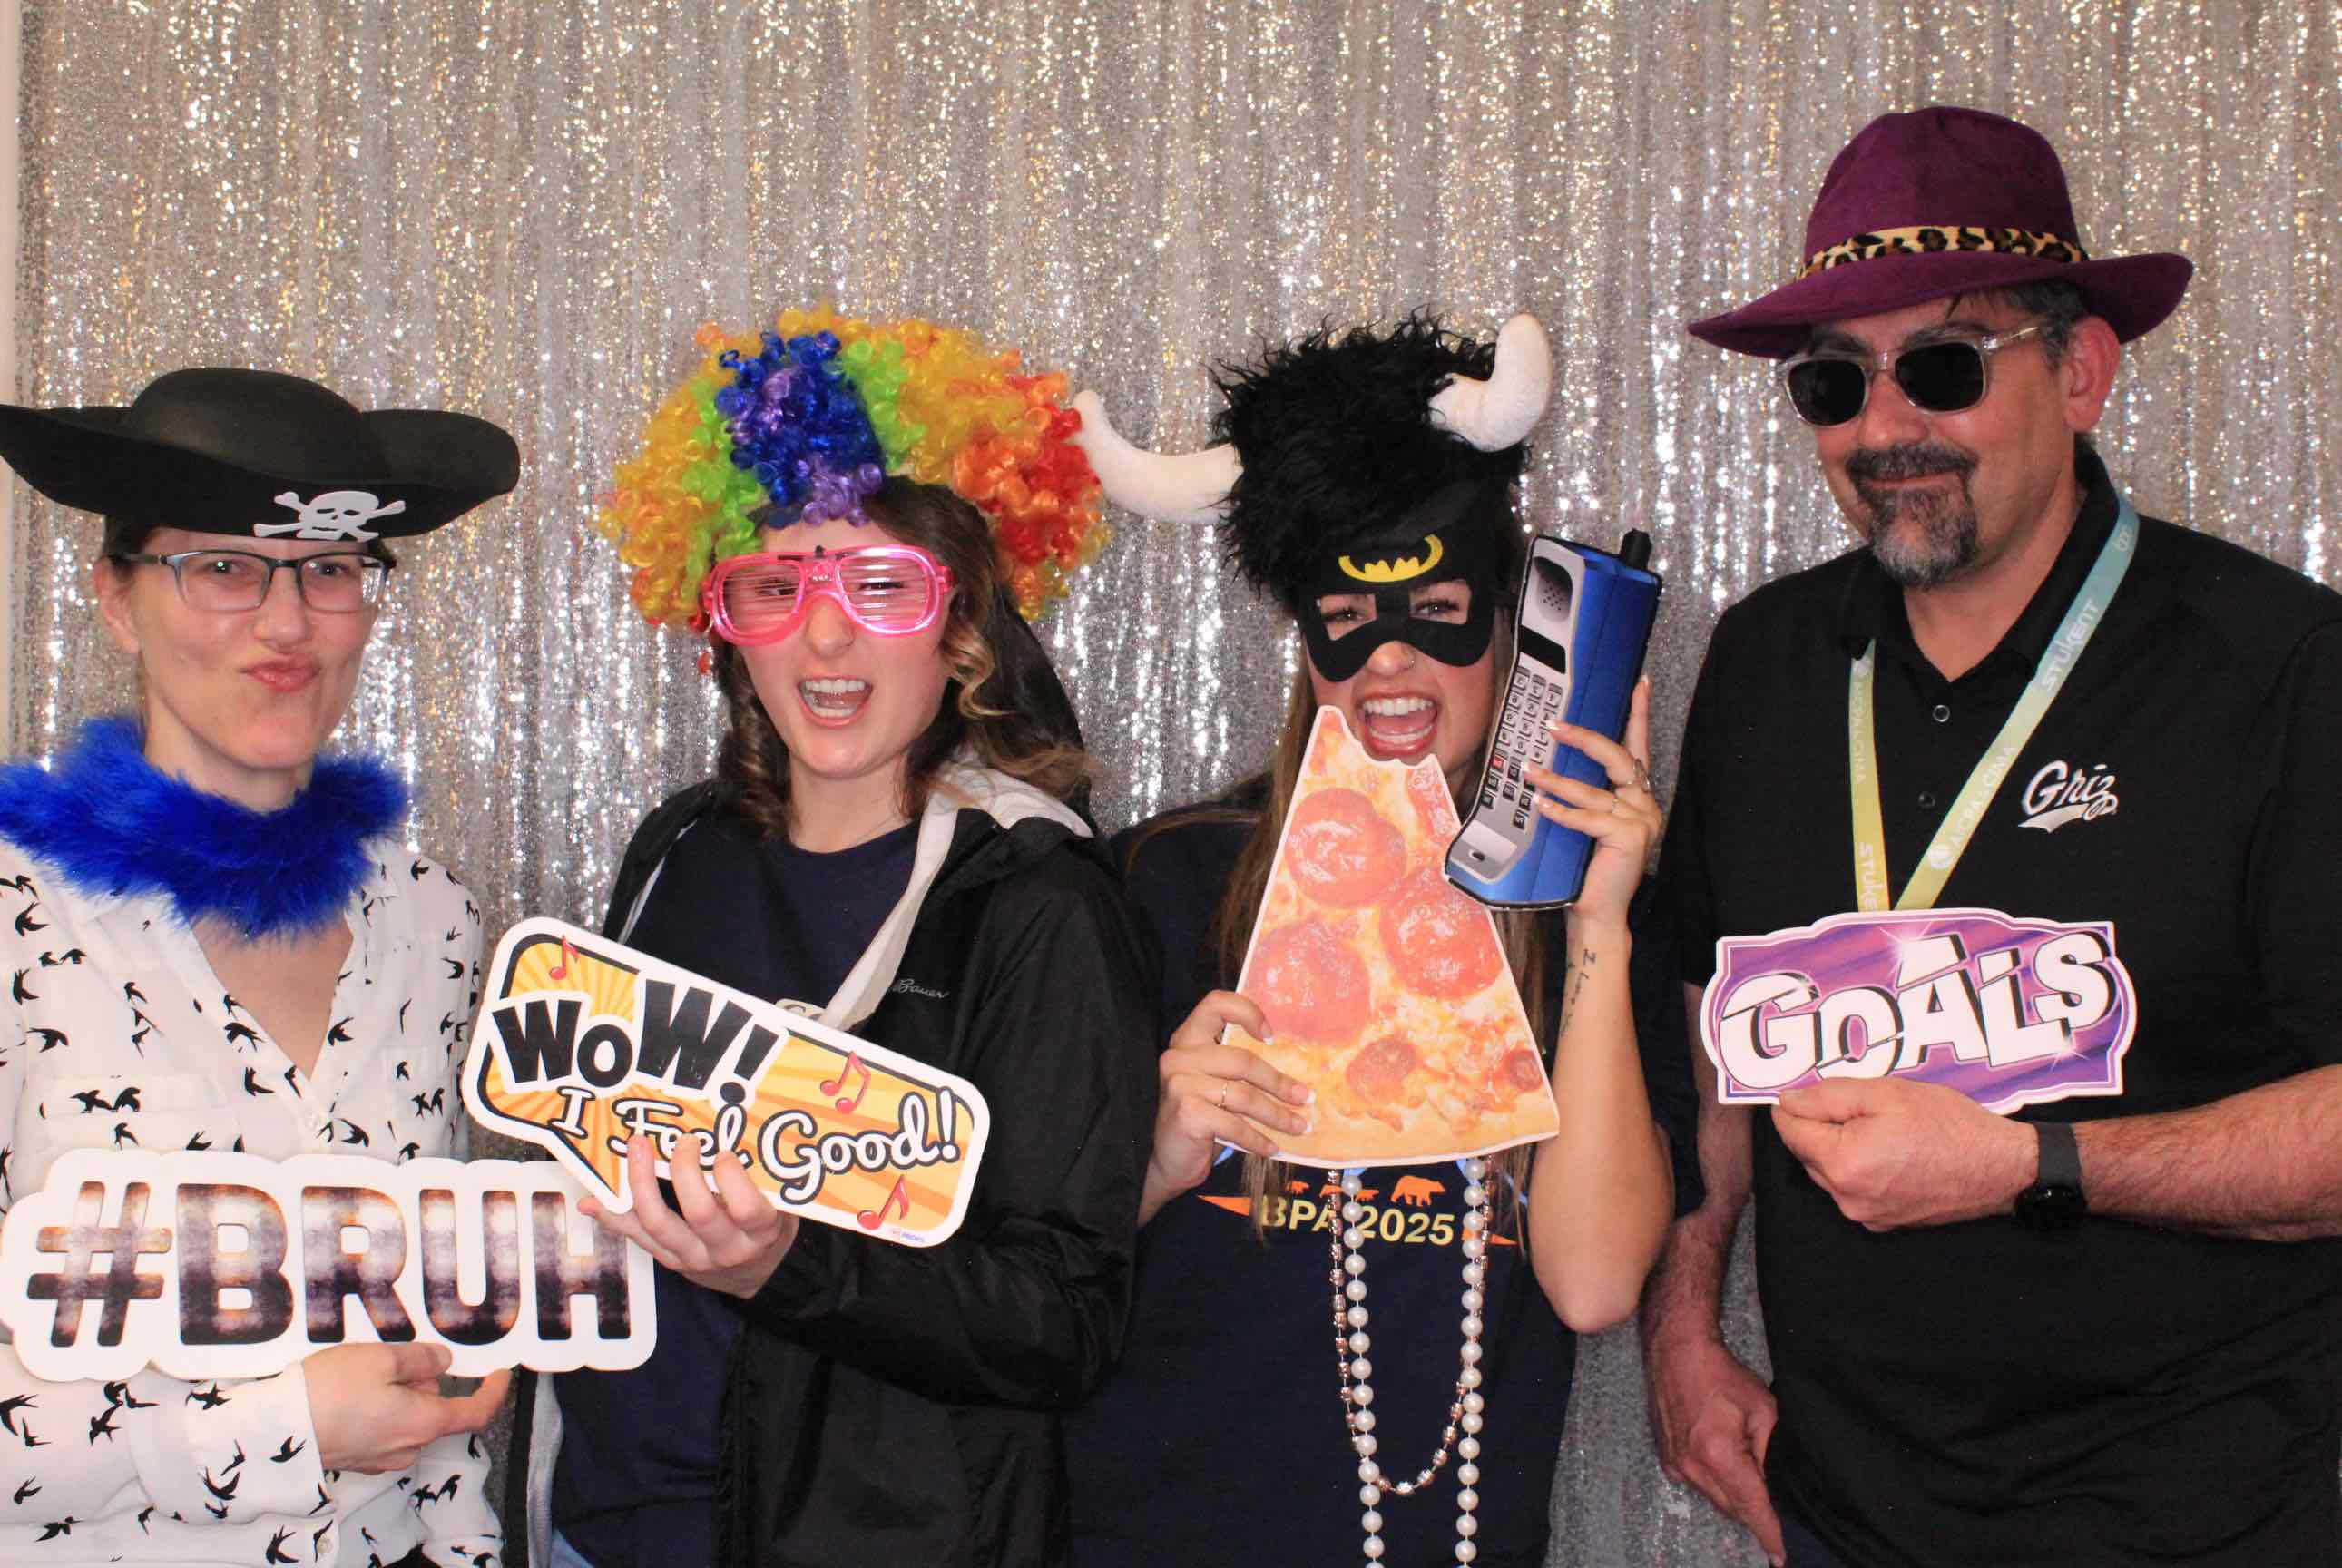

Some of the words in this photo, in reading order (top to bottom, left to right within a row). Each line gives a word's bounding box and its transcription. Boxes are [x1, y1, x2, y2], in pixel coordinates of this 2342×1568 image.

[2021, 760, 2118, 821] Griz
[899, 978, 950, 999] Bauer
[1719, 931, 2112, 1089] GOALS
[545, 1086, 596, 1139] I
[758, 1086, 962, 1205] Good!
[27, 1181, 632, 1348] #BRUH
[1360, 1205, 1455, 1246] 2025
